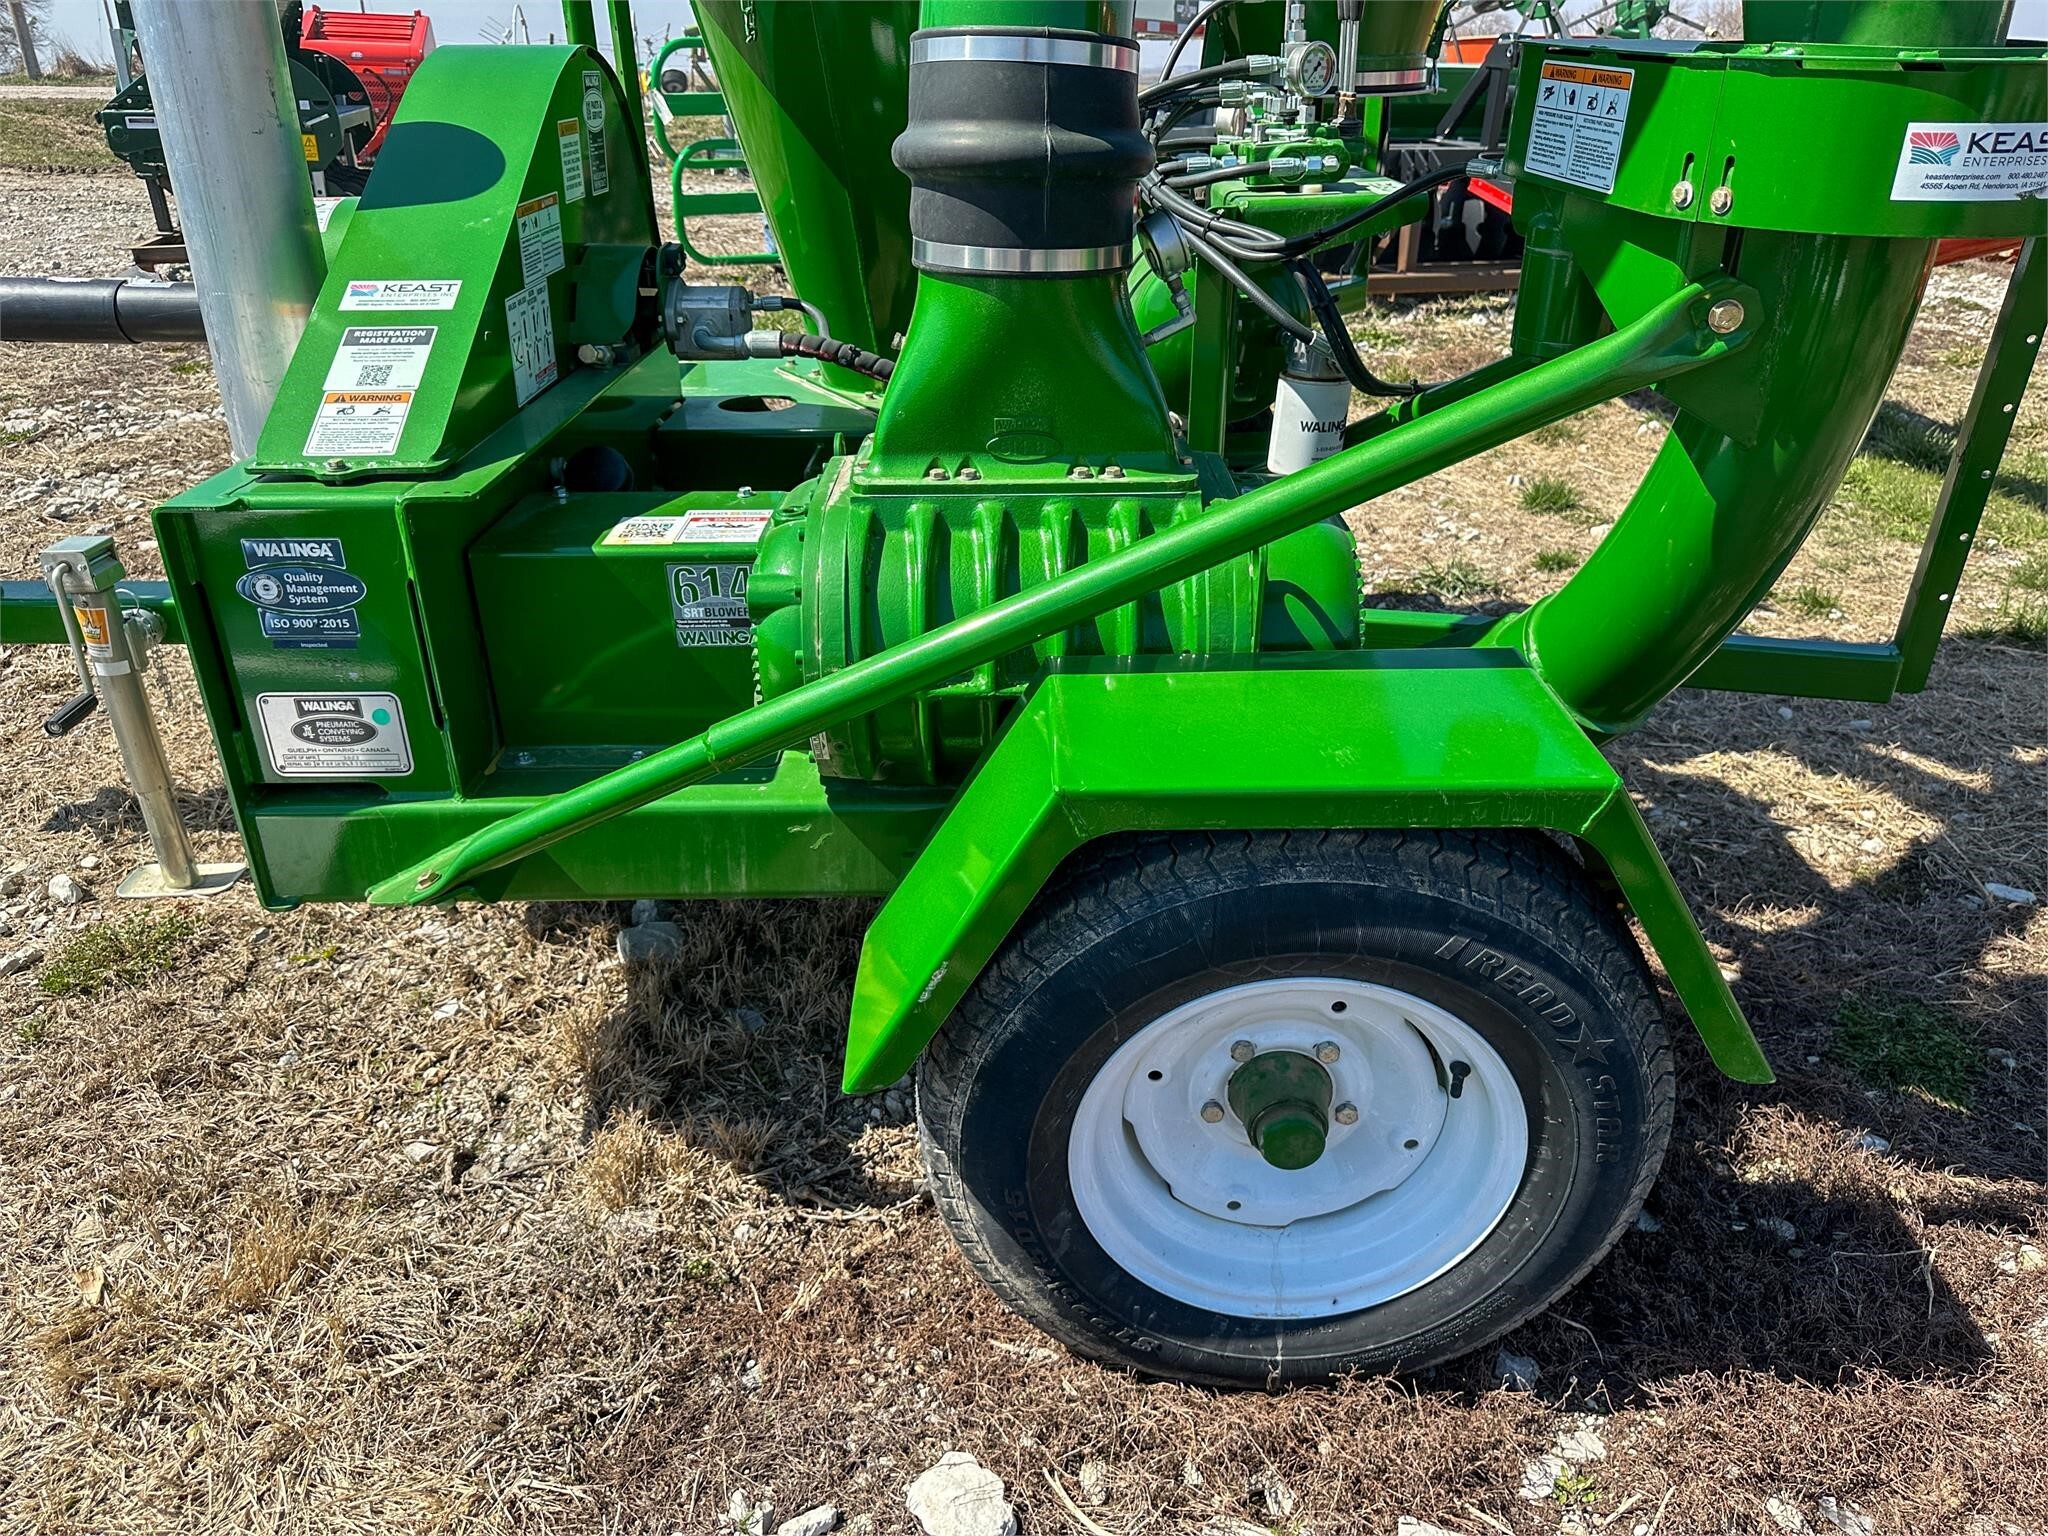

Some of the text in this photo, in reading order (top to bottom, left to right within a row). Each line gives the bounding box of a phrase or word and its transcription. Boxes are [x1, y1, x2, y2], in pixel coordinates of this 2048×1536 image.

[1555, 67, 1577, 79] WARNING
[1597, 73, 1623, 85] WARNING
[1966, 131, 2048, 154] KEAS
[1962, 155, 2047, 168] ENTERPRISES
[1924, 172, 2001, 182] keastenterprises.com
[1943, 183, 1968, 191] Aspen
[383, 283, 458, 293] KEAST
[353, 329, 427, 338] REGISTRATION
[390, 336, 417, 344] EASY
[349, 394, 402, 403] WARNING
[1300, 420, 1345, 434] WALING
[252, 542, 334, 558] WALINGA
[283, 572, 324, 584] Quality
[286, 584, 359, 596] Management
[672, 565, 749, 608] 614
[288, 594, 329, 605] System
[270, 618, 290, 629] ISO
[300, 701, 356, 712] WALINGA
[315, 721, 360, 729] PNEUMATIC
[317, 728, 365, 736] CONVEYING
[319, 735, 351, 743] SYSTEMS
[1435, 929, 1622, 1163] TREAD STAR
